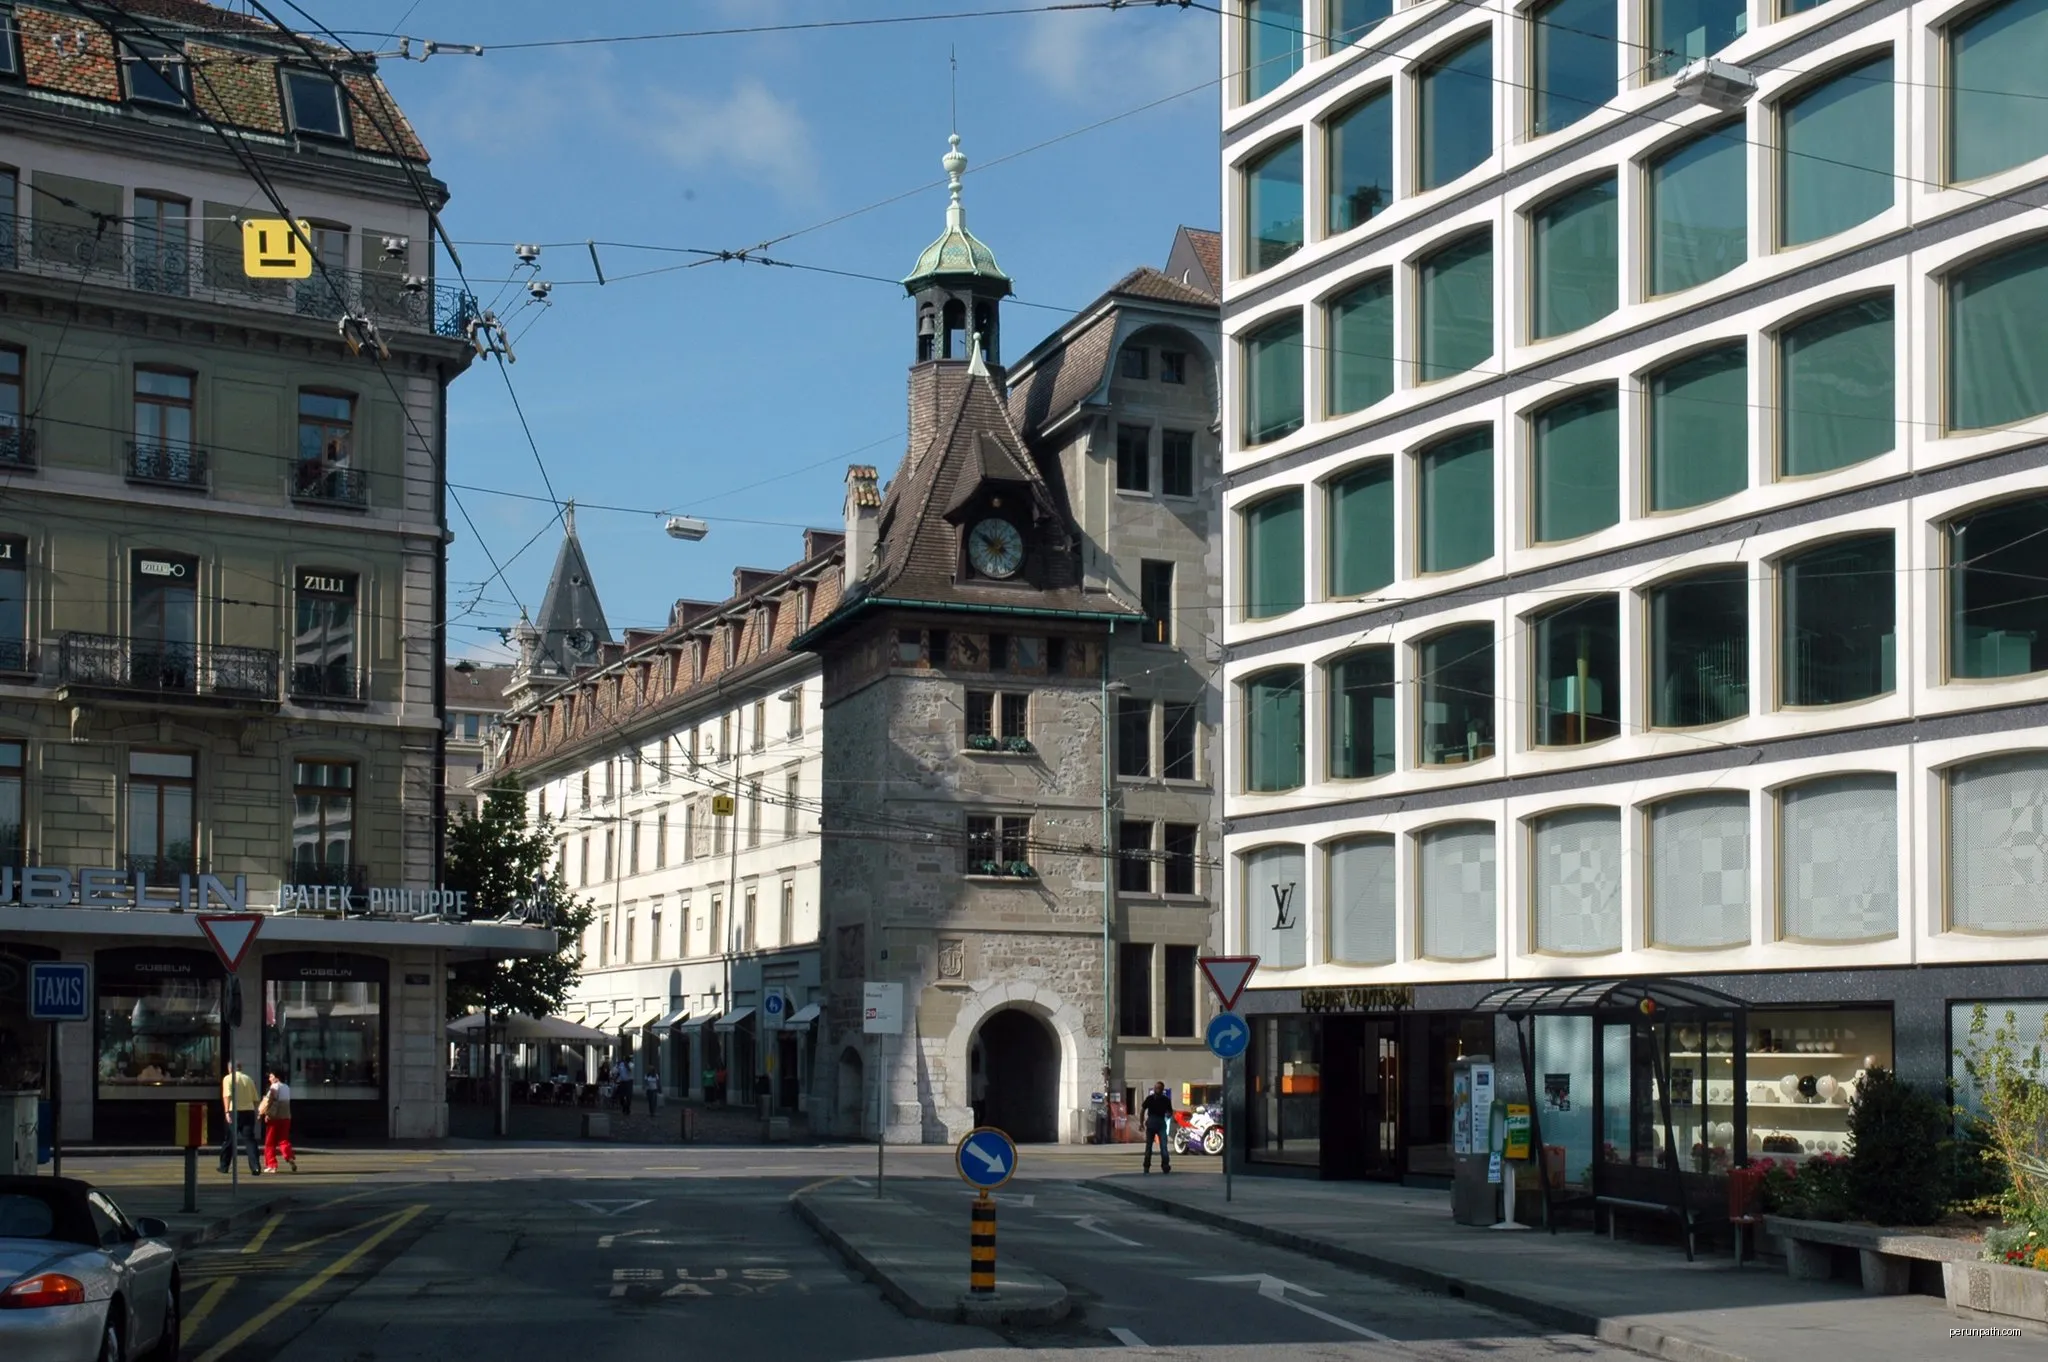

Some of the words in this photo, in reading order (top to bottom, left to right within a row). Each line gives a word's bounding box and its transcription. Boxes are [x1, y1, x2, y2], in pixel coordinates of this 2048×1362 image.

[304, 575, 344, 593] ZILLI
[280, 883, 353, 911] PATEK
[368, 886, 468, 916] PHILIPPE
[36, 976, 81, 1006] TAXIS
[612, 1268, 793, 1281] BUS
